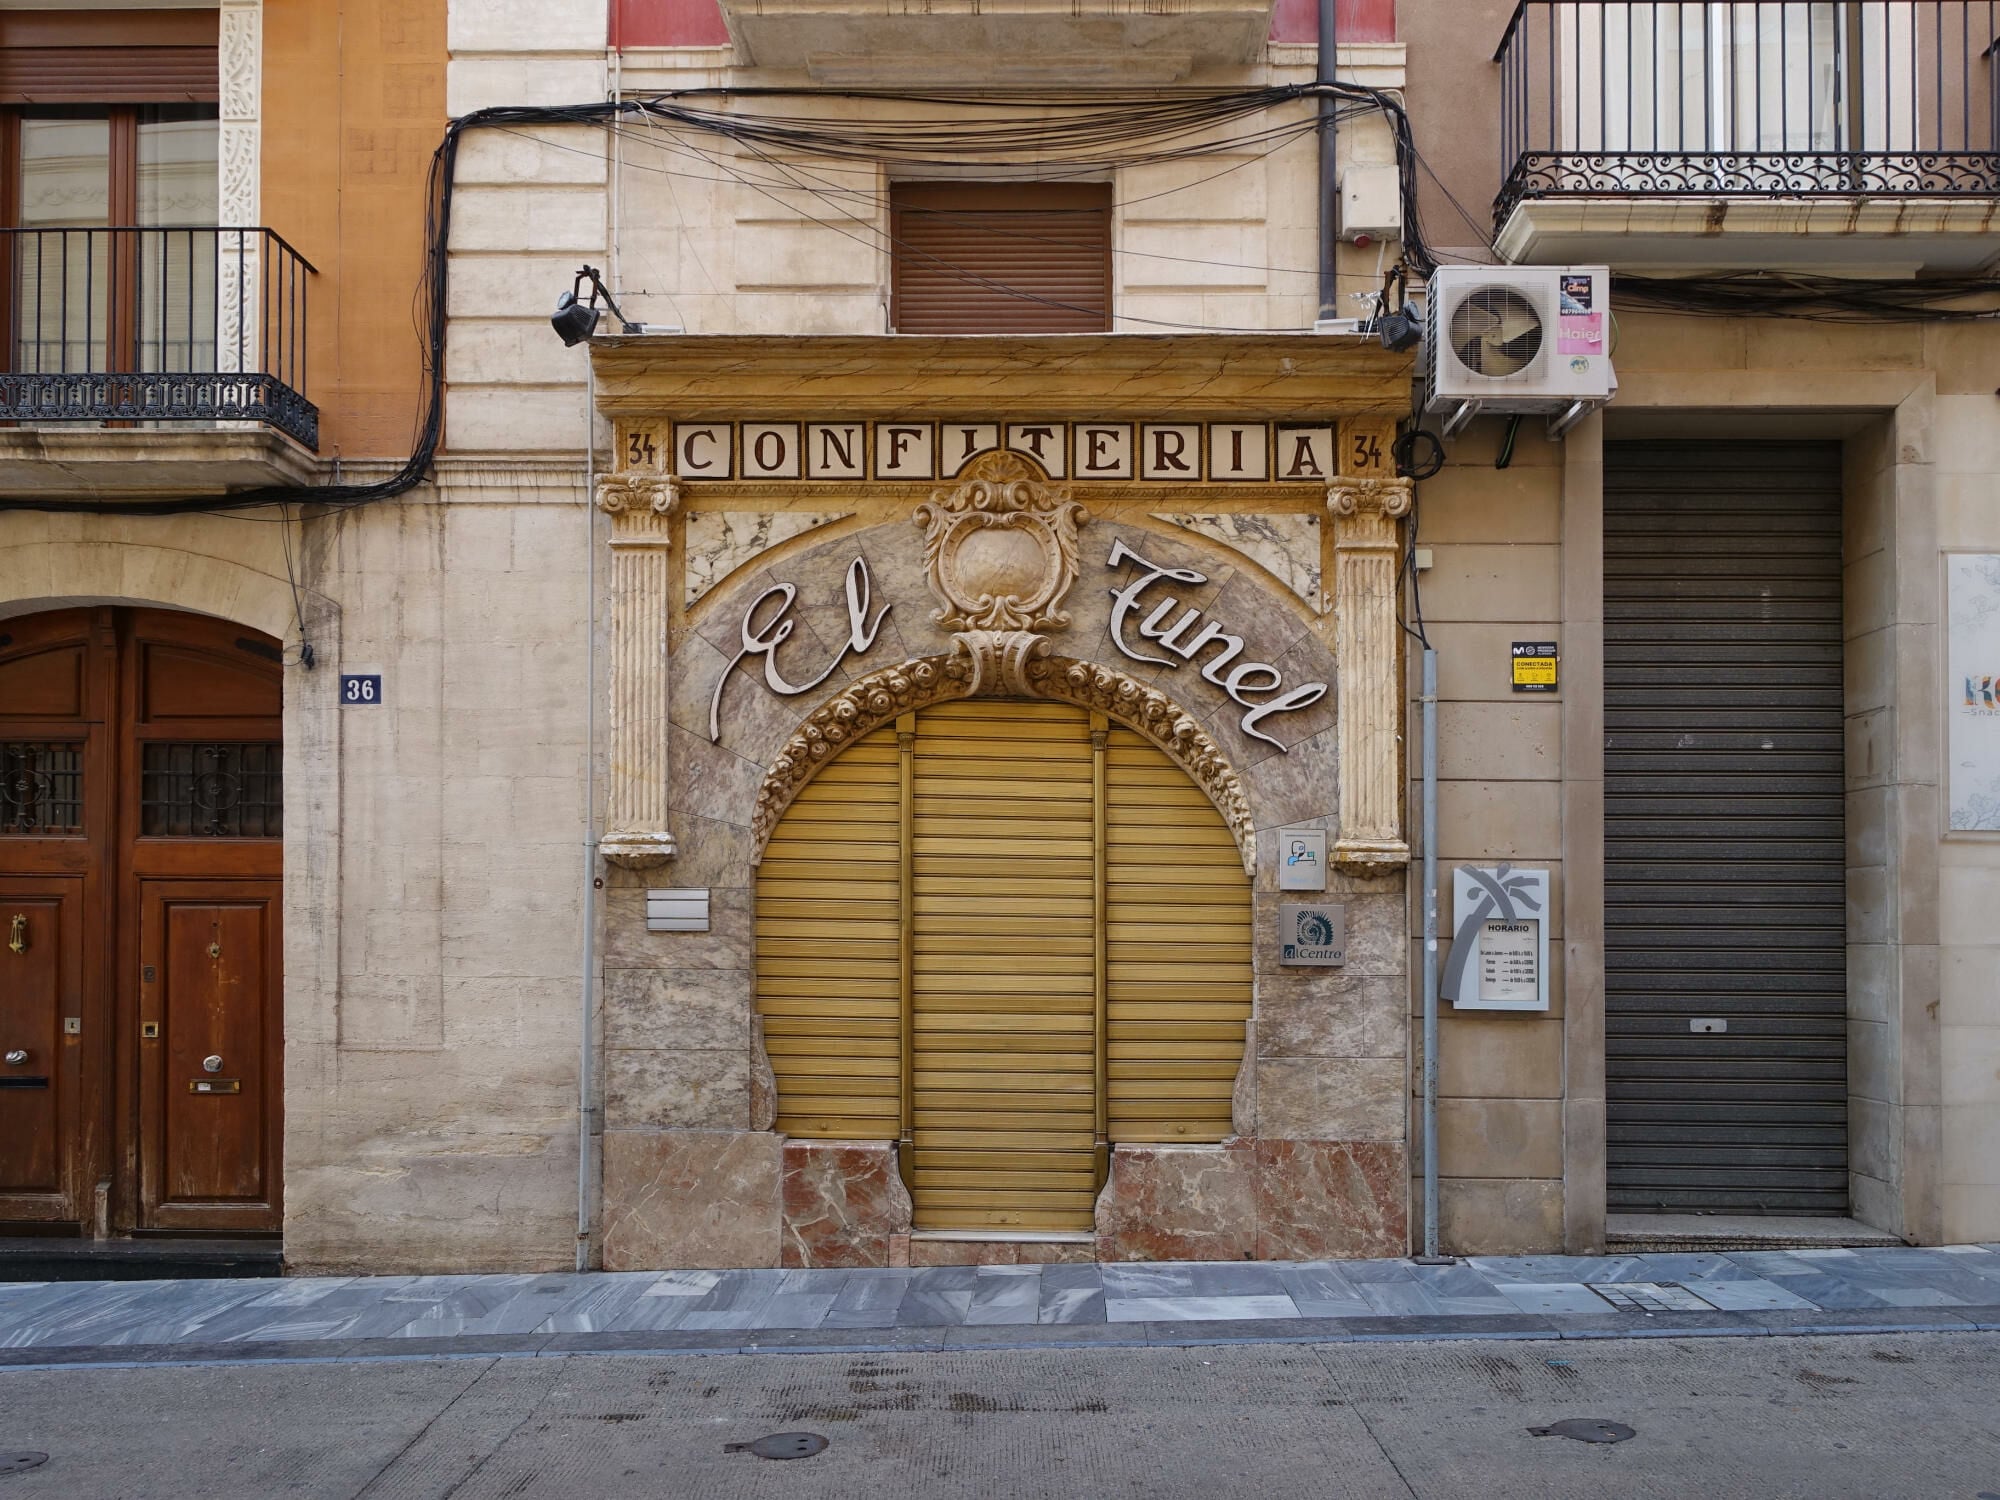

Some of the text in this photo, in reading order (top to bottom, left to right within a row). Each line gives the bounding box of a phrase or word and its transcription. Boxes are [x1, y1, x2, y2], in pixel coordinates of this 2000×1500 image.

[1559, 327, 1601, 340] Haier
[629, 433, 656, 465] 34
[684, 428, 1324, 477] CONFITERIA
[1353, 435, 1382, 468] 34
[709, 536, 1329, 753] El Tunel
[346, 679, 374, 700] 36
[1488, 924, 1530, 933] HORARIO
